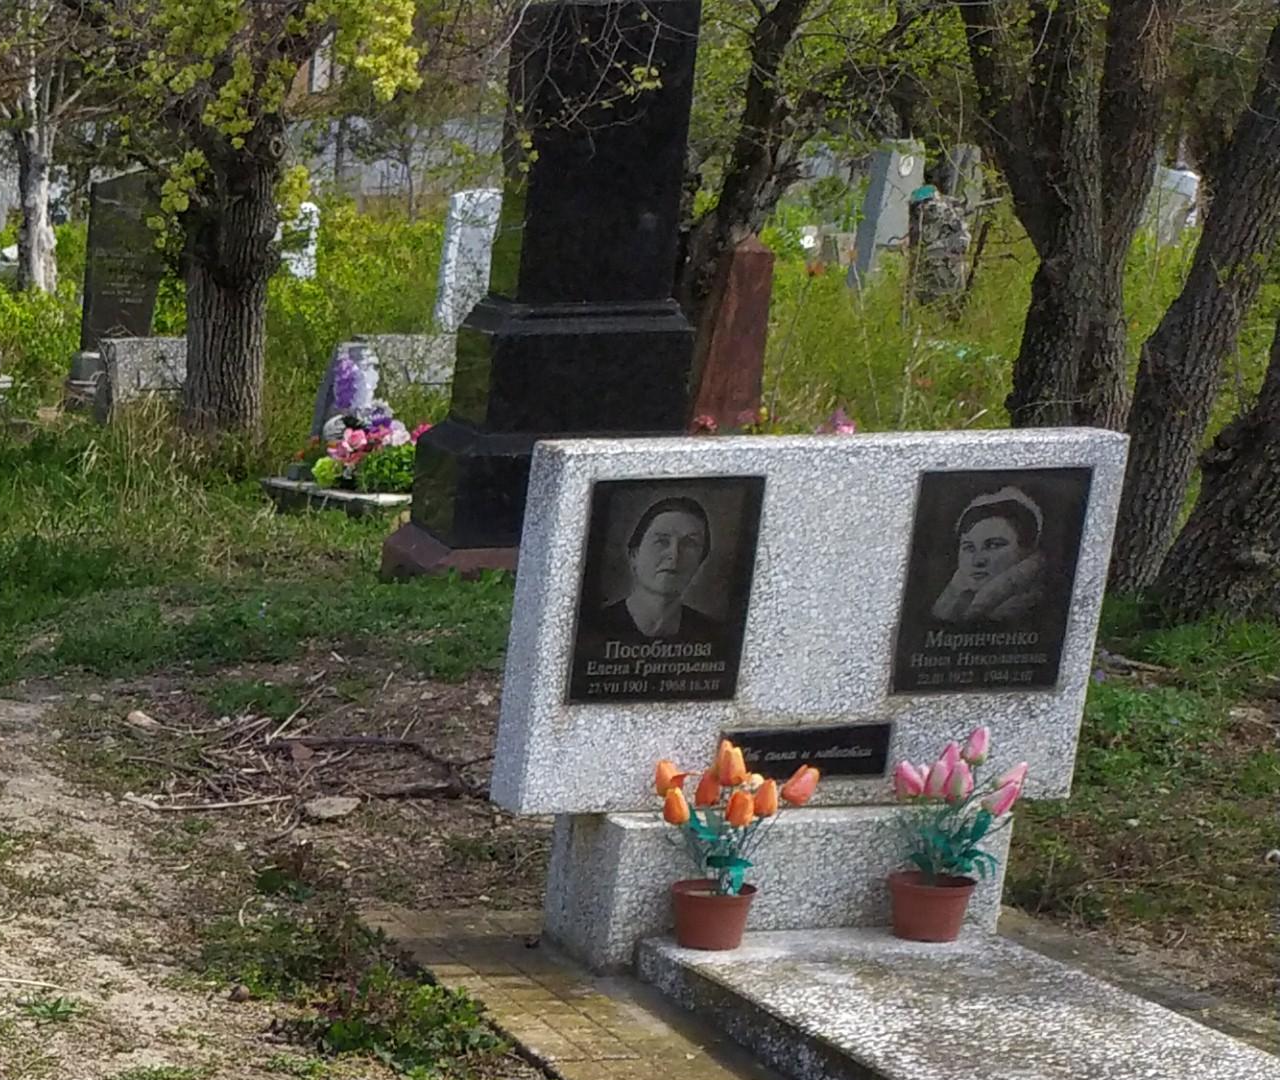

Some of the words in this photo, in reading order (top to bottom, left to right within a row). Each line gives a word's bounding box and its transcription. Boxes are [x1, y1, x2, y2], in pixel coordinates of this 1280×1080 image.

[604, 640, 712, 659] Пособилова
[924, 630, 1039, 650] Маринченко
[586, 661, 630, 675] Елена
[634, 660, 726, 677] Григорьевна
